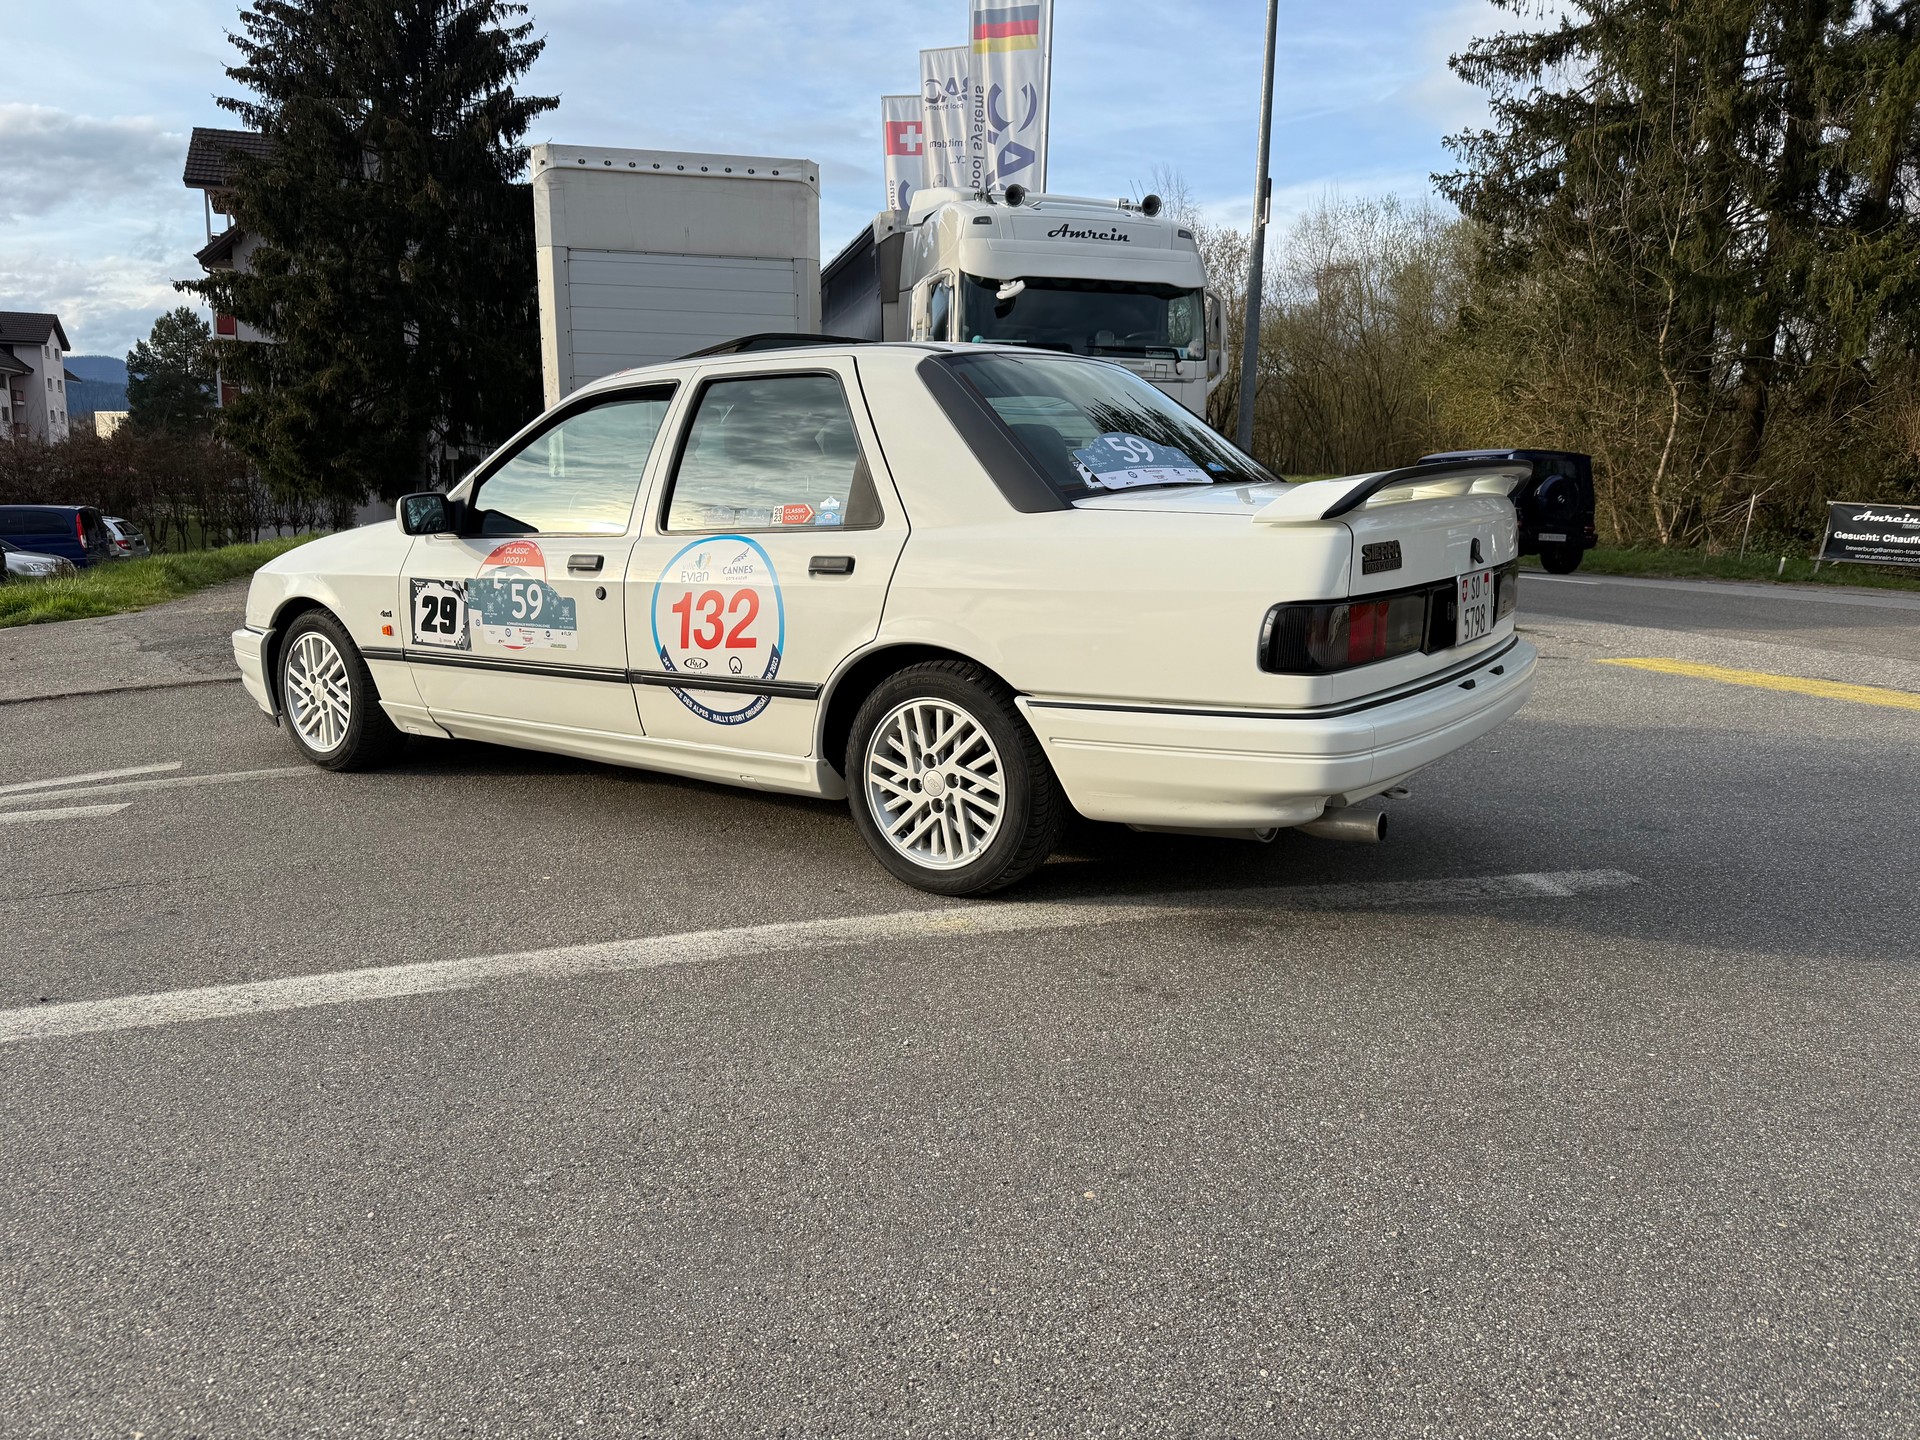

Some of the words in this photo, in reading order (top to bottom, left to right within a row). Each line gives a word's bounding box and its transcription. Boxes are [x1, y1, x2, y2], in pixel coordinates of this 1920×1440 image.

[1047, 223, 1130, 242] Amrein
[1104, 436, 1155, 464] 59
[774, 507, 783, 515] 20
[774, 514, 782, 523] 23
[785, 507, 806, 515] CLASSIC
[1852, 510, 1920, 524] Amrein
[1834, 530, 1880, 542] Gesucht:
[504, 546, 530, 555] CLASSIC
[1362, 540, 1402, 562] SIERRA
[722, 564, 754, 575] CANNES
[1471, 575, 1480, 600] SO
[511, 583, 544, 621] 59
[421, 595, 458, 635] 29
[671, 587, 760, 650] 132
[1464, 603, 1486, 640] 5798
[682, 696, 693, 708] DES
[692, 703, 709, 718] ALPES
[712, 713, 729, 723] RALLY
[729, 714, 745, 724] STORY
[769, 656, 779, 674] 2023
